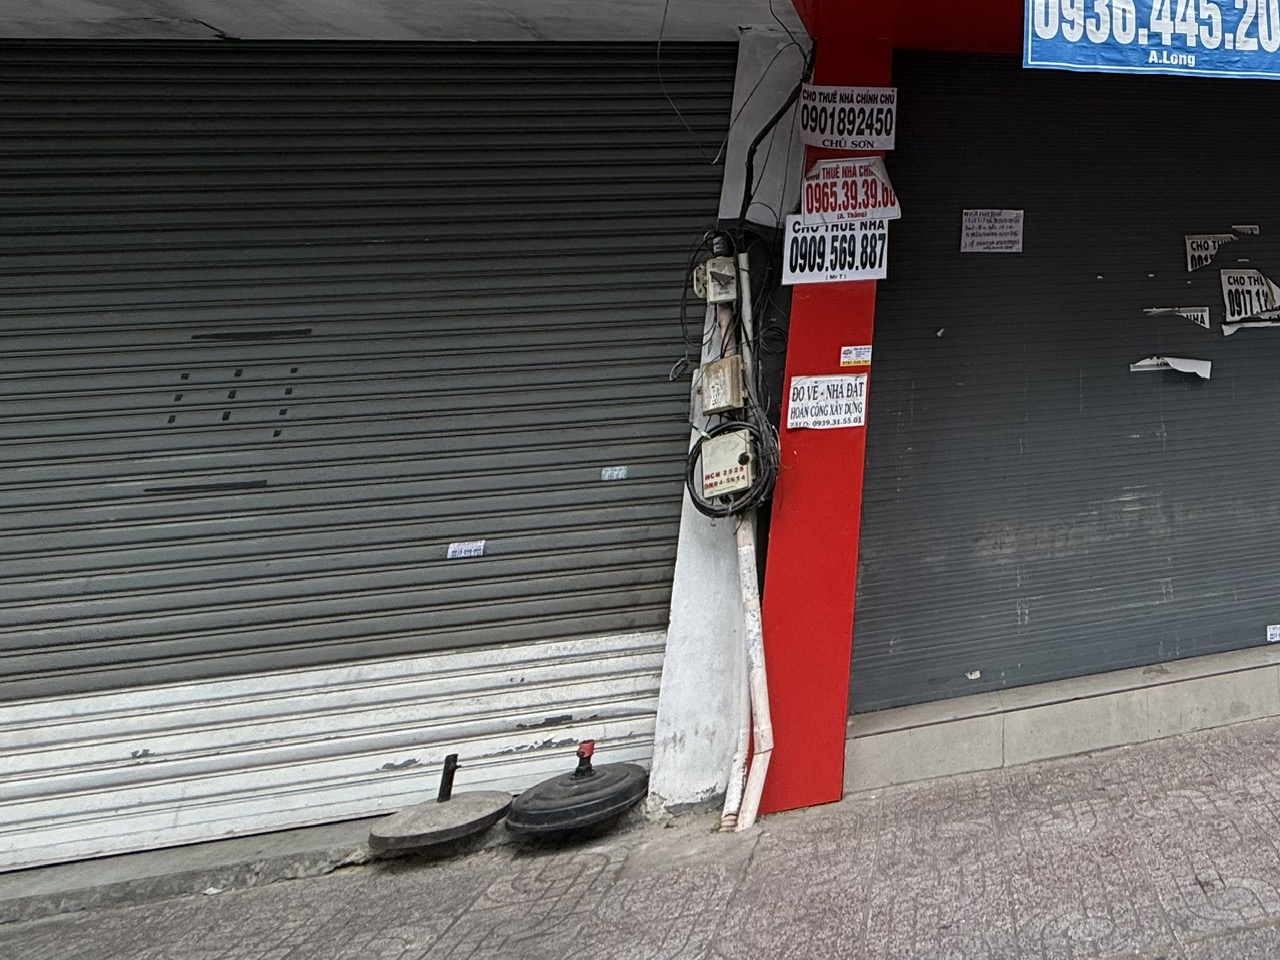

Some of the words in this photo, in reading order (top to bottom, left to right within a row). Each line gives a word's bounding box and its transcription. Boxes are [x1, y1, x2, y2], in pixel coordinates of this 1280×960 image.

[1149, 51, 1195, 67] A.Long
[803, 89, 816, 101] CHO
[819, 90, 837, 103] THUÊ
[839, 92, 854, 104] NHÀ
[856, 90, 878, 104] CHÍNH
[880, 89, 894, 104] CHỦ
[801, 104, 893, 136] 0901892450
[822, 138, 846, 147] CHÚ
[822, 165, 839, 179] THUÊ
[842, 163, 857, 178] NHÀ
[790, 233, 886, 273] 0909.569.887
[1191, 241, 1209, 251] CHO
[1228, 276, 1245, 286] CHO
[792, 387, 804, 402] ĐO
[826, 379, 844, 399] NHÀ
